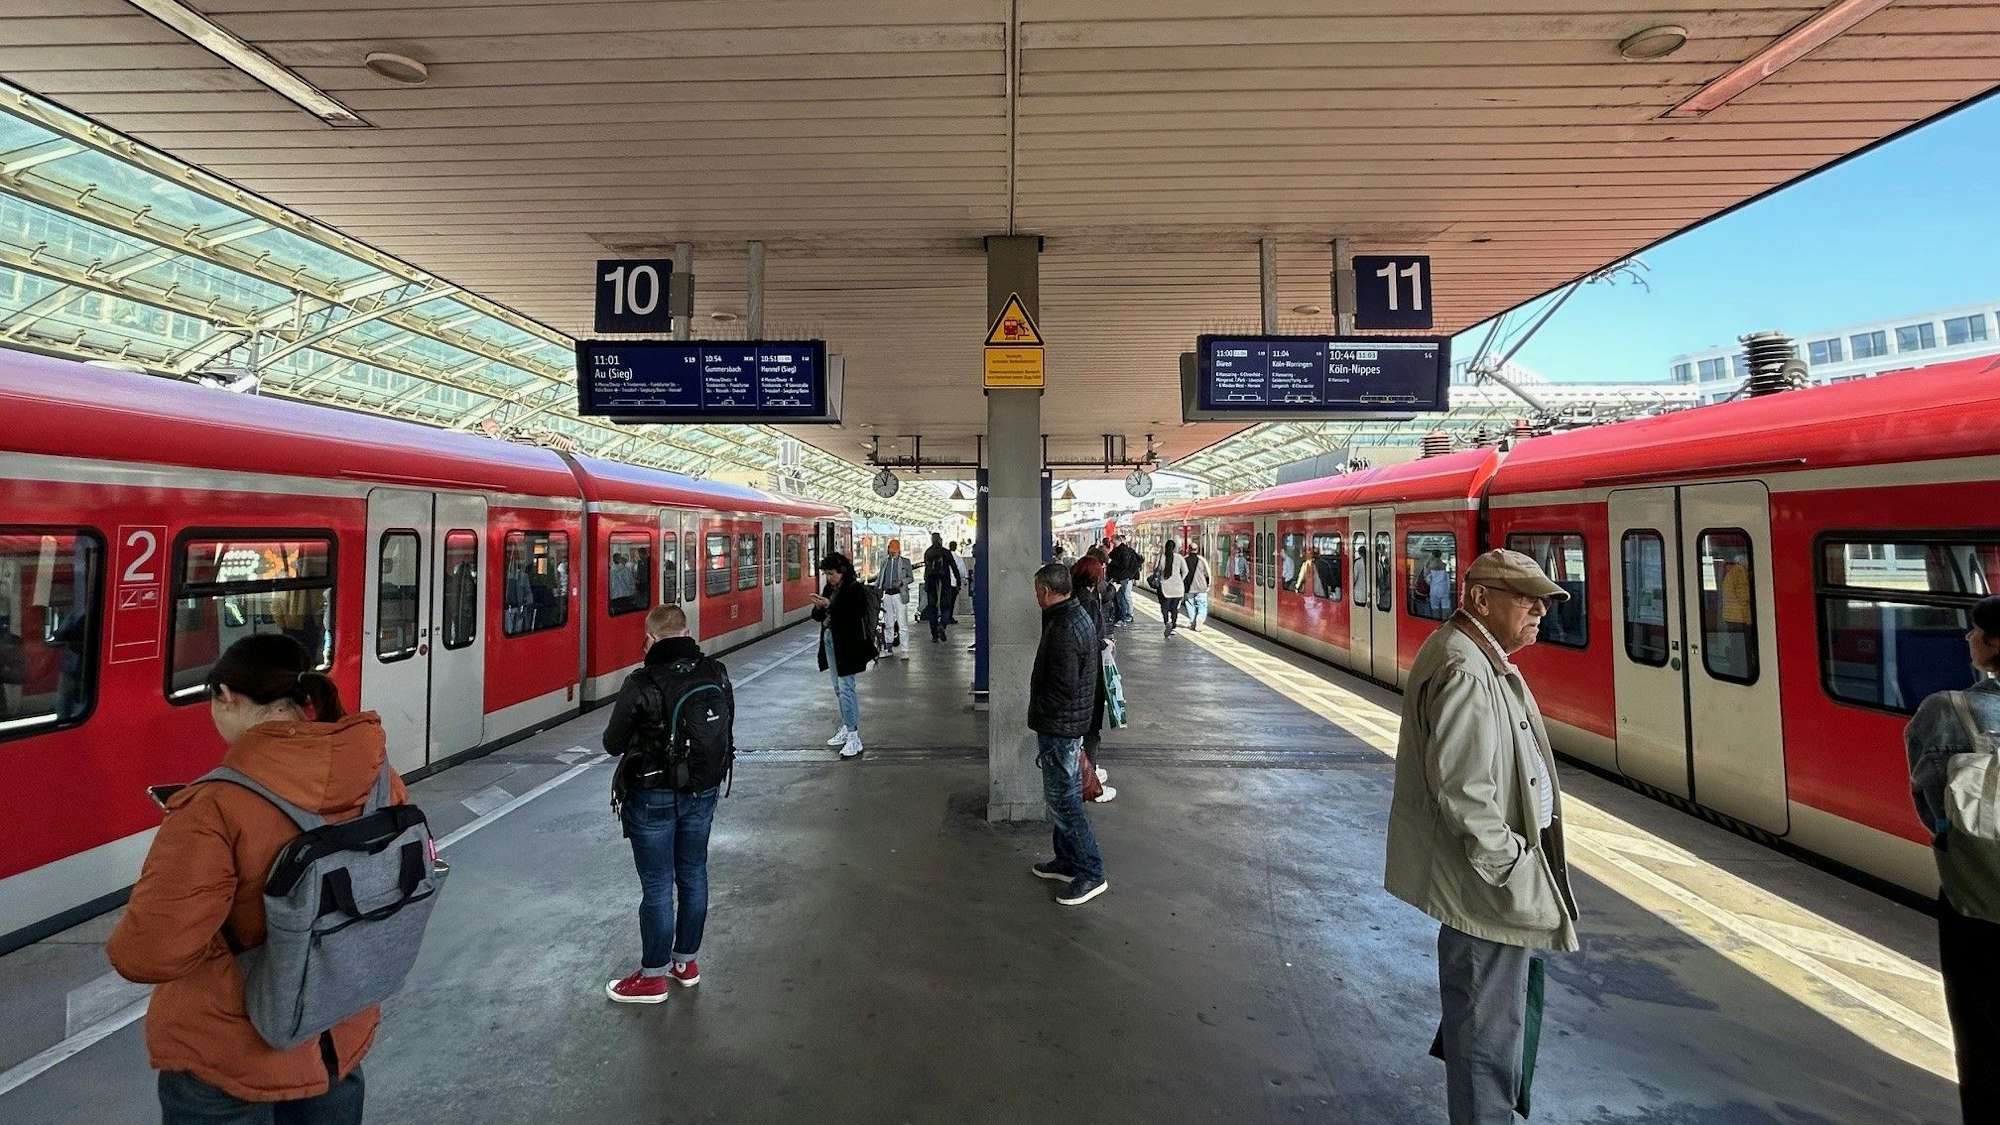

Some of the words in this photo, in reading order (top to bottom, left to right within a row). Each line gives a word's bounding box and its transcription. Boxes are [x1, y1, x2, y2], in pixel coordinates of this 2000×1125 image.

[604, 266, 659, 315] 10
[1376, 262, 1422, 310] 11
[594, 355, 620, 365] 11:01
[1330, 351, 1355, 360] 10:44
[595, 368, 606, 379] Au
[608, 368, 633, 380] (Sieg)
[781, 366, 796, 374] (Sieg)
[1329, 364, 1380, 376] Köln-Nippes
[123, 531, 156, 582] 2
